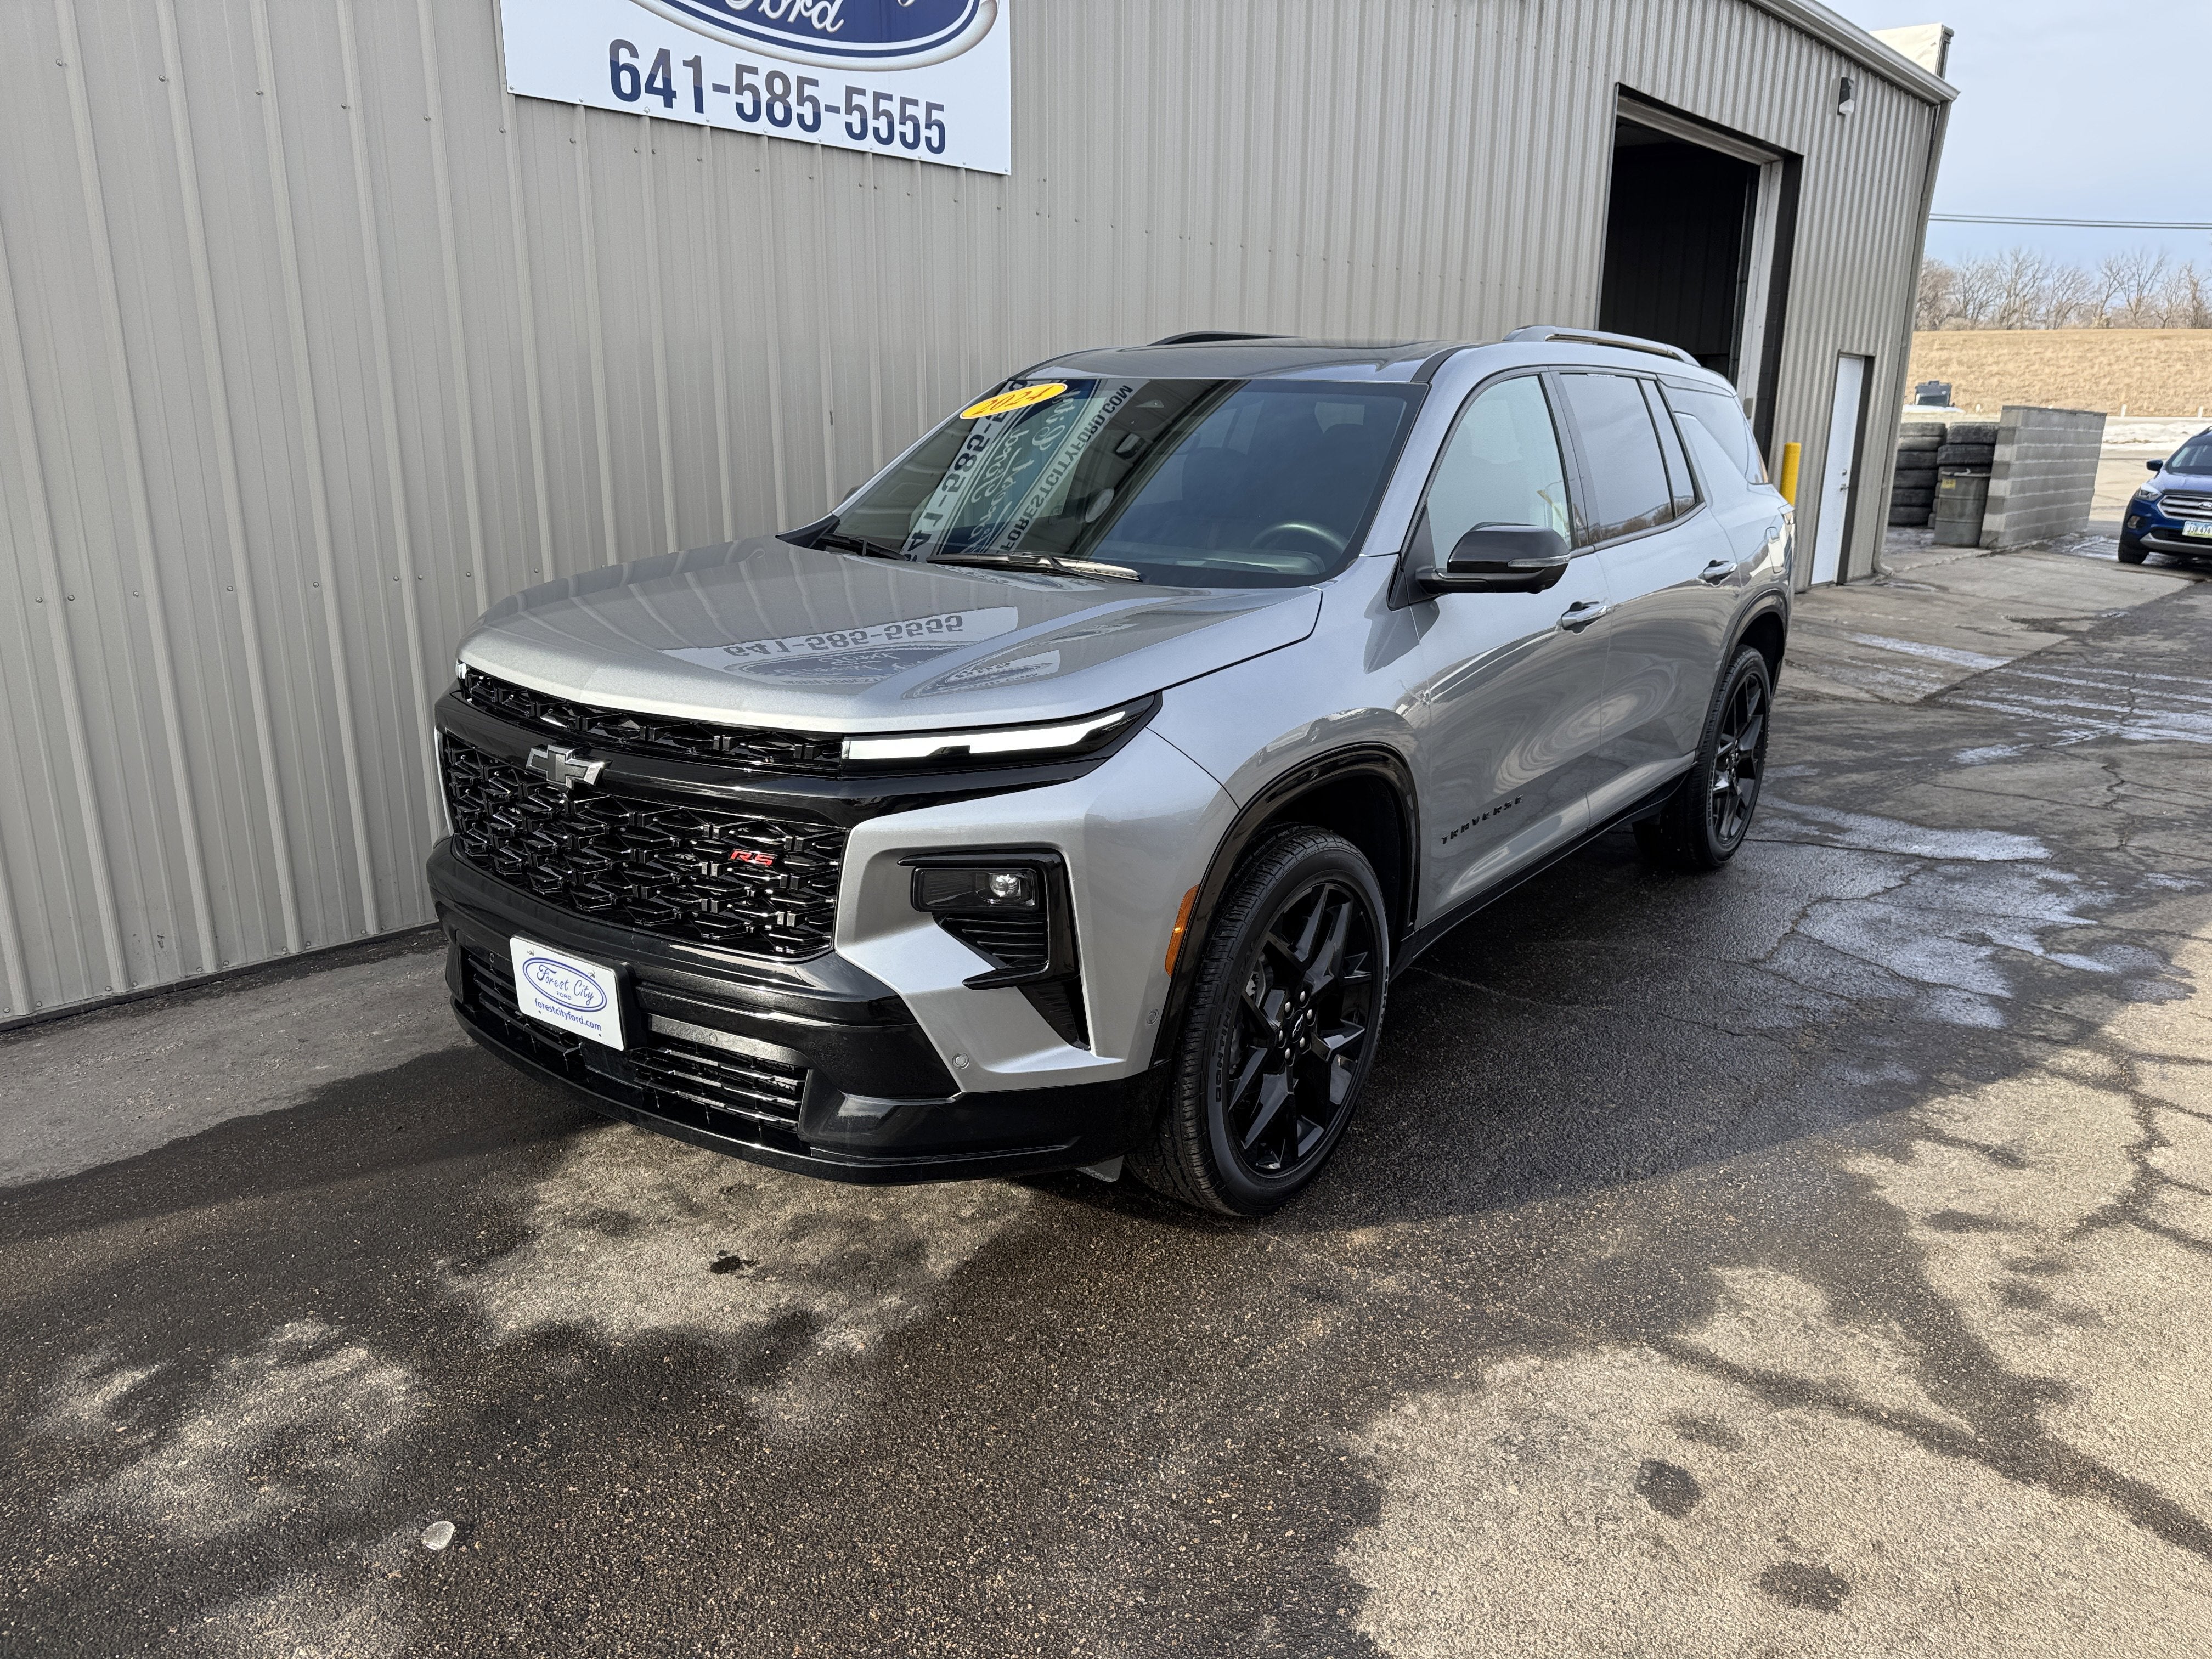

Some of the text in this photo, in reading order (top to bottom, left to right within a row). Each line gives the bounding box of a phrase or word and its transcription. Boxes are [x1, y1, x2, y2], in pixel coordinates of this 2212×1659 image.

[609, 39, 946, 155] 641-585-5555
[970, 386, 1054, 415] 2024
[1441, 794, 1523, 844] TRAVERSE
[729, 849, 776, 866] RS
[536, 964, 594, 1005] Forest City
[556, 991, 572, 1001] FORD
[534, 998, 602, 1031] forestcityford.com
